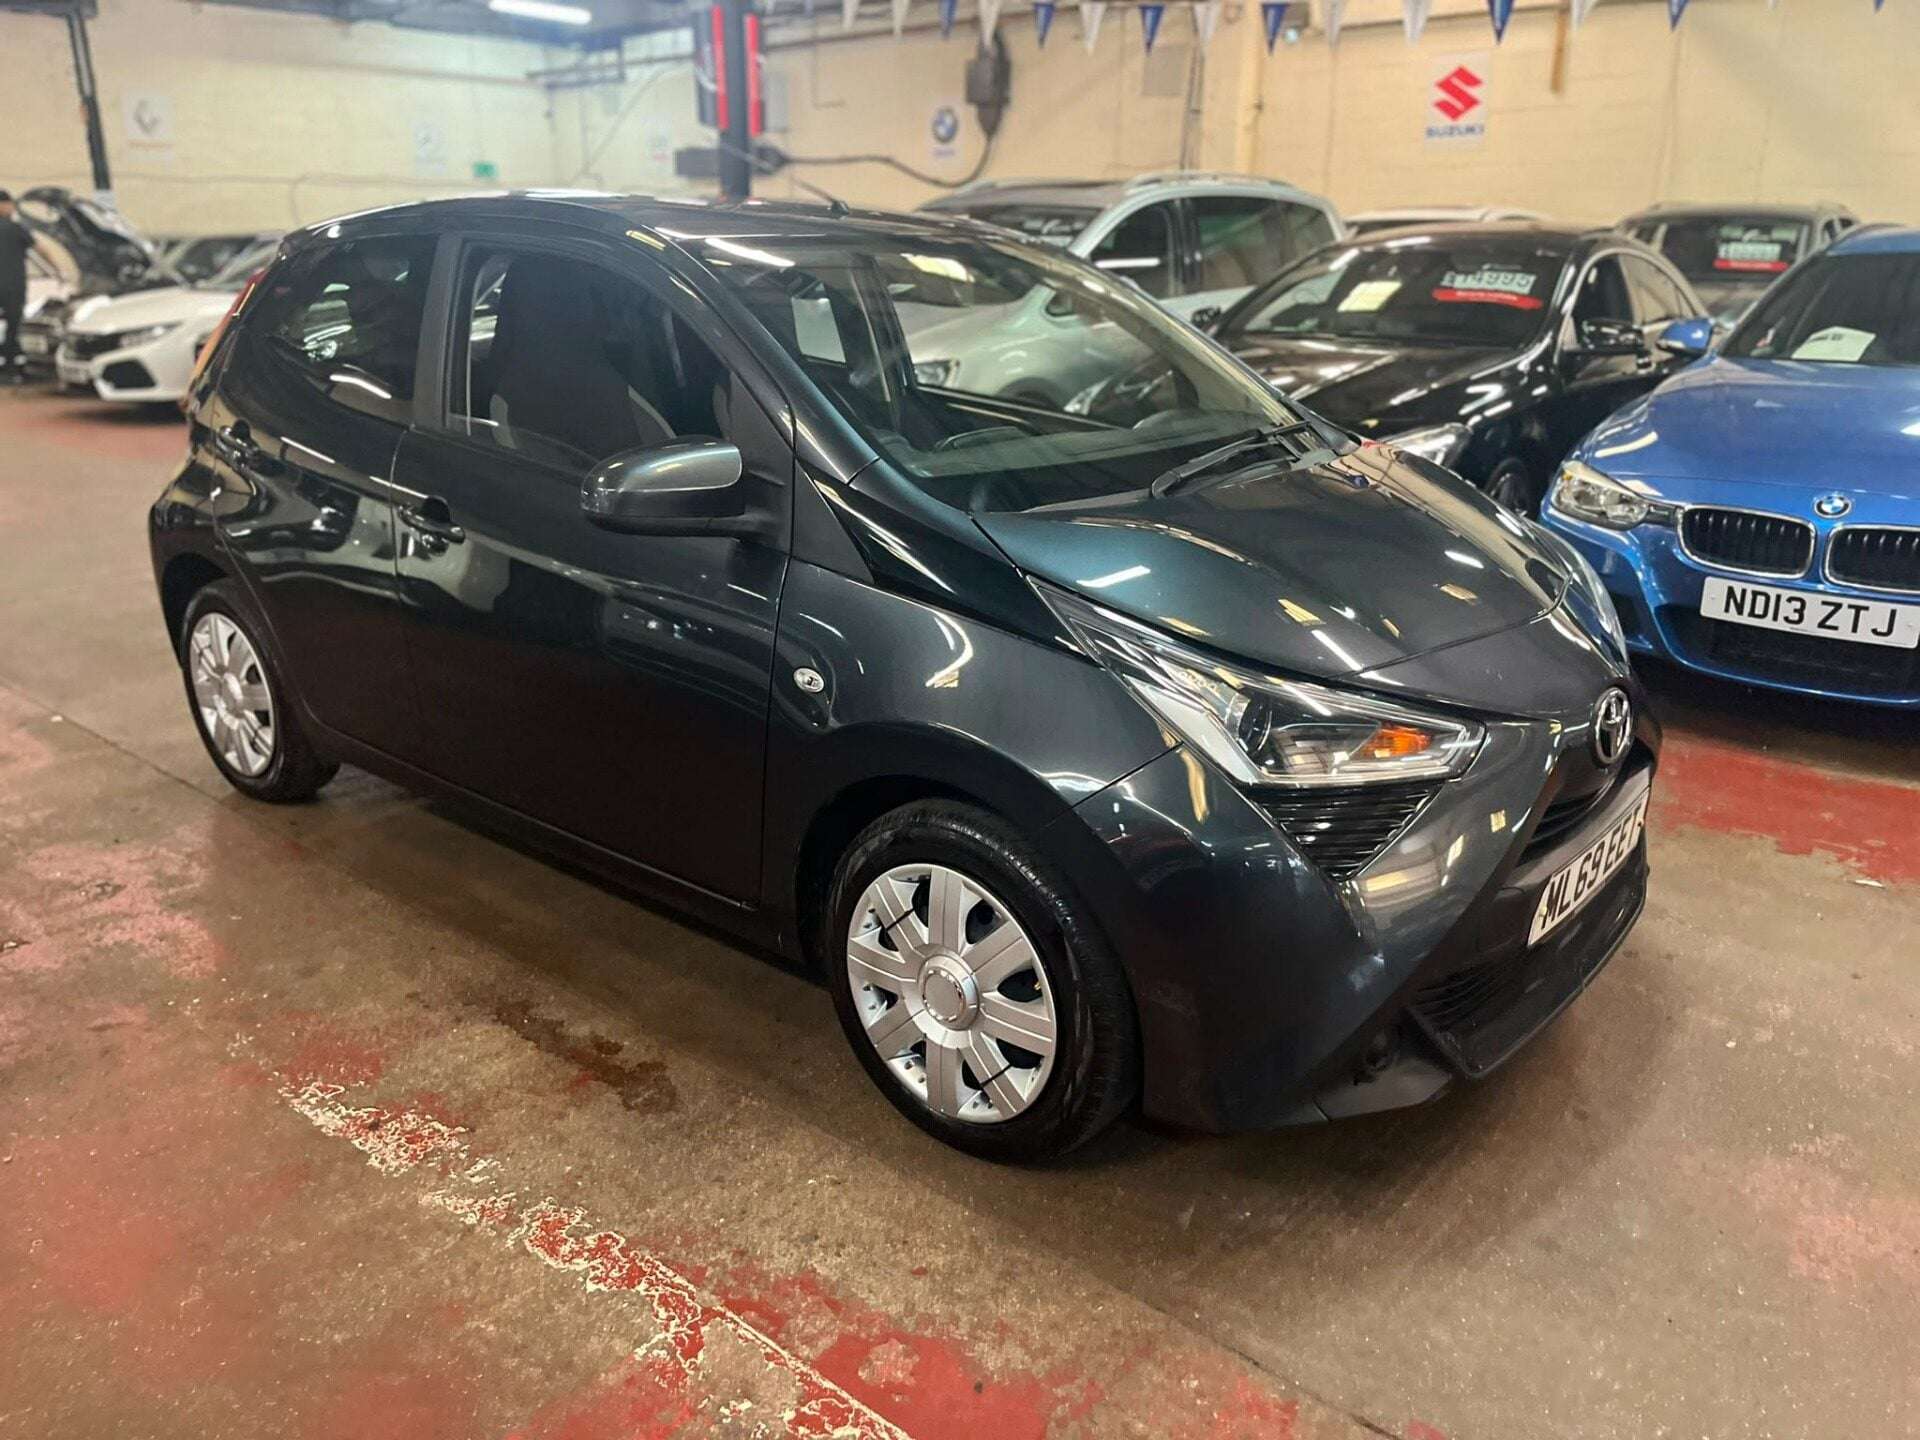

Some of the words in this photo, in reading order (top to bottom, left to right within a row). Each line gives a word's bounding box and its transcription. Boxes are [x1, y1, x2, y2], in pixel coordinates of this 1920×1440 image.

[1724, 585, 1807, 625] ND13
[1817, 600, 1897, 637] ZTJ
[1540, 839, 1606, 930] ML69
